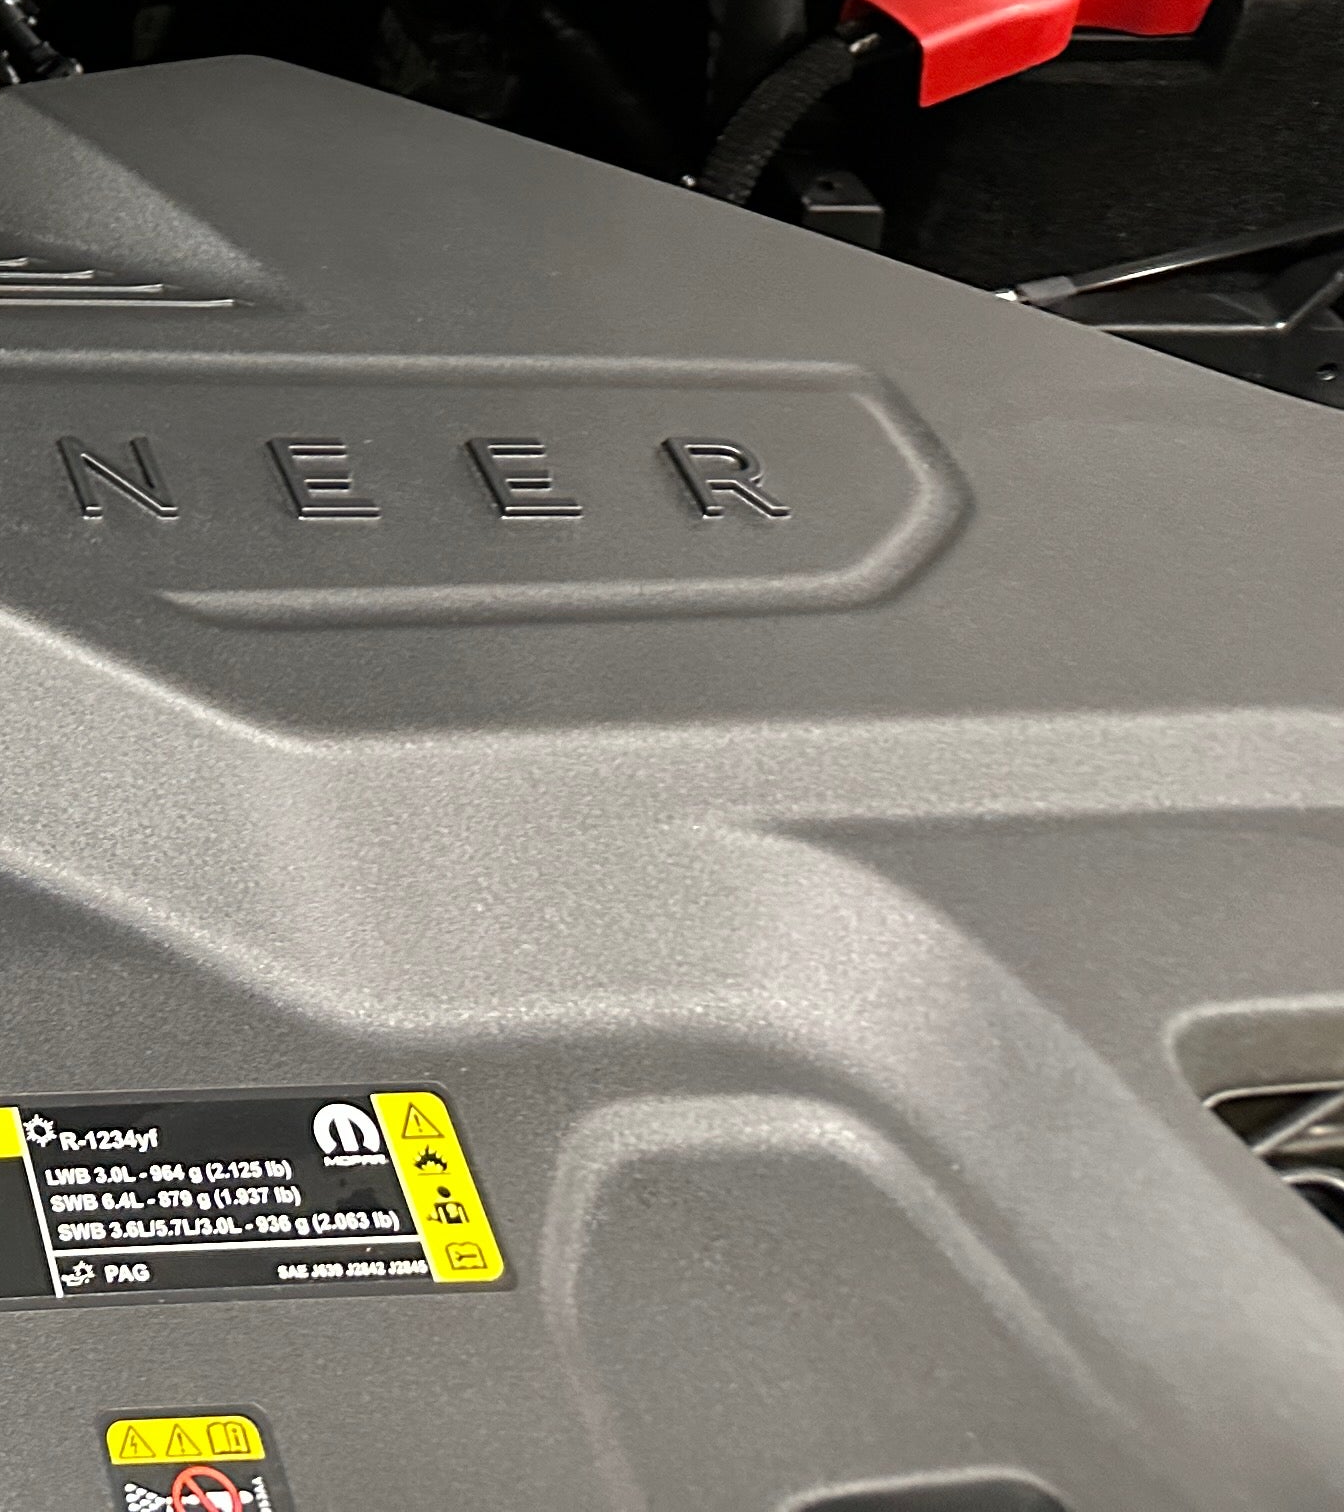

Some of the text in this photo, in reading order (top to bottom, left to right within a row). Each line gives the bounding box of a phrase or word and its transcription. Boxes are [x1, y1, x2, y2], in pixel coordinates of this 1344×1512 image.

[59, 1127, 159, 1153] R-1234yf
[45, 1168, 92, 1187] LWB
[92, 1166, 137, 1184] 3.0L
[150, 1163, 186, 1182] 964
[188, 1166, 204, 1184] g
[205, 1162, 263, 1183] (2.125
[264, 1160, 293, 1180] lb)
[50, 1194, 99, 1213] SWB
[101, 1192, 145, 1210] 6.4L
[158, 1190, 194, 1208] 879
[196, 1192, 212, 1210] g
[213, 1187, 270, 1209] (1.937
[273, 1185, 302, 1207] lb)
[57, 1223, 107, 1242] SWB
[109, 1216, 243, 1239] 3.6L/5.7L/3.0L
[255, 1215, 292, 1234] 936
[294, 1217, 310, 1236] g
[312, 1213, 370, 1235] (2.063
[371, 1210, 400, 1232] lb)
[104, 1263, 151, 1283] PAG
[277, 1264, 309, 1280] SAE
